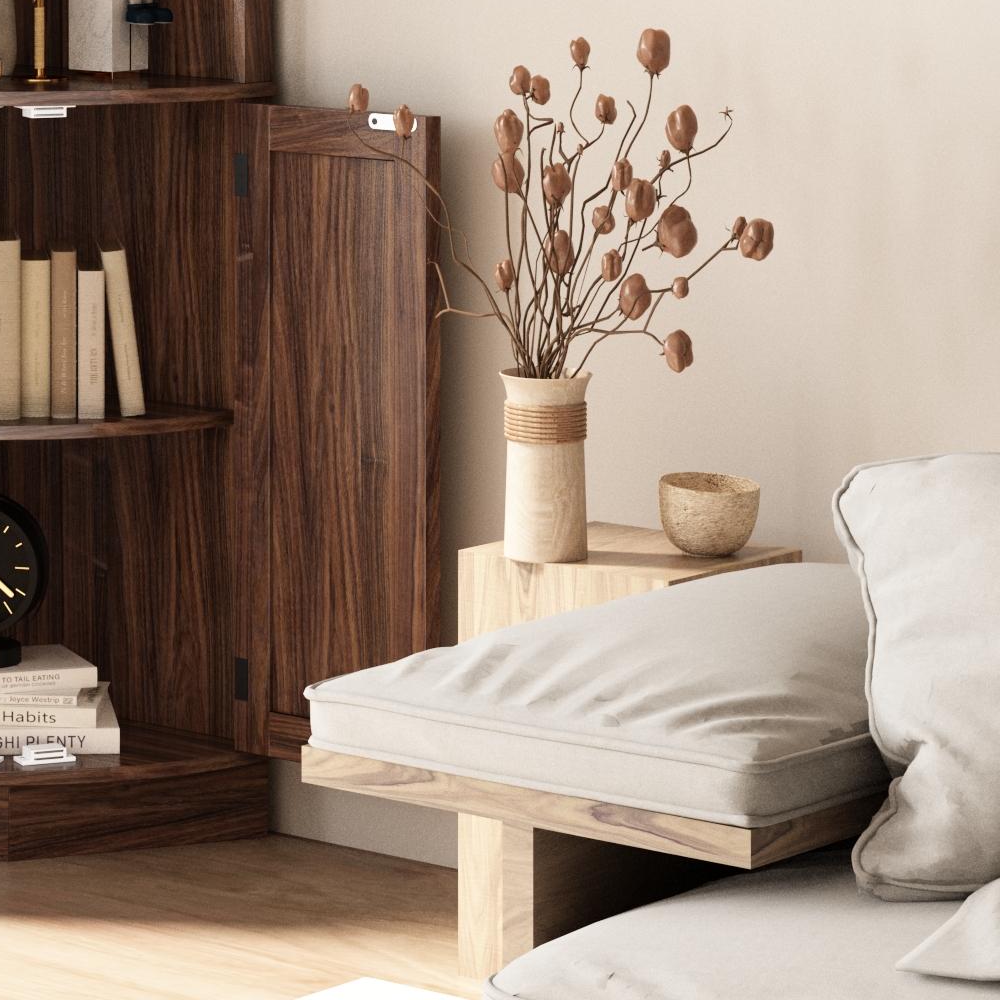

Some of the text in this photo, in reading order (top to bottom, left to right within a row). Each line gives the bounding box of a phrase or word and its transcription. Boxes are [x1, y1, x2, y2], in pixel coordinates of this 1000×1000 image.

[2, 676, 12, 684] TO
[14, 675, 29, 683] TAIL
[32, 673, 61, 682] EATING
[2, 711, 57, 724] Habits
